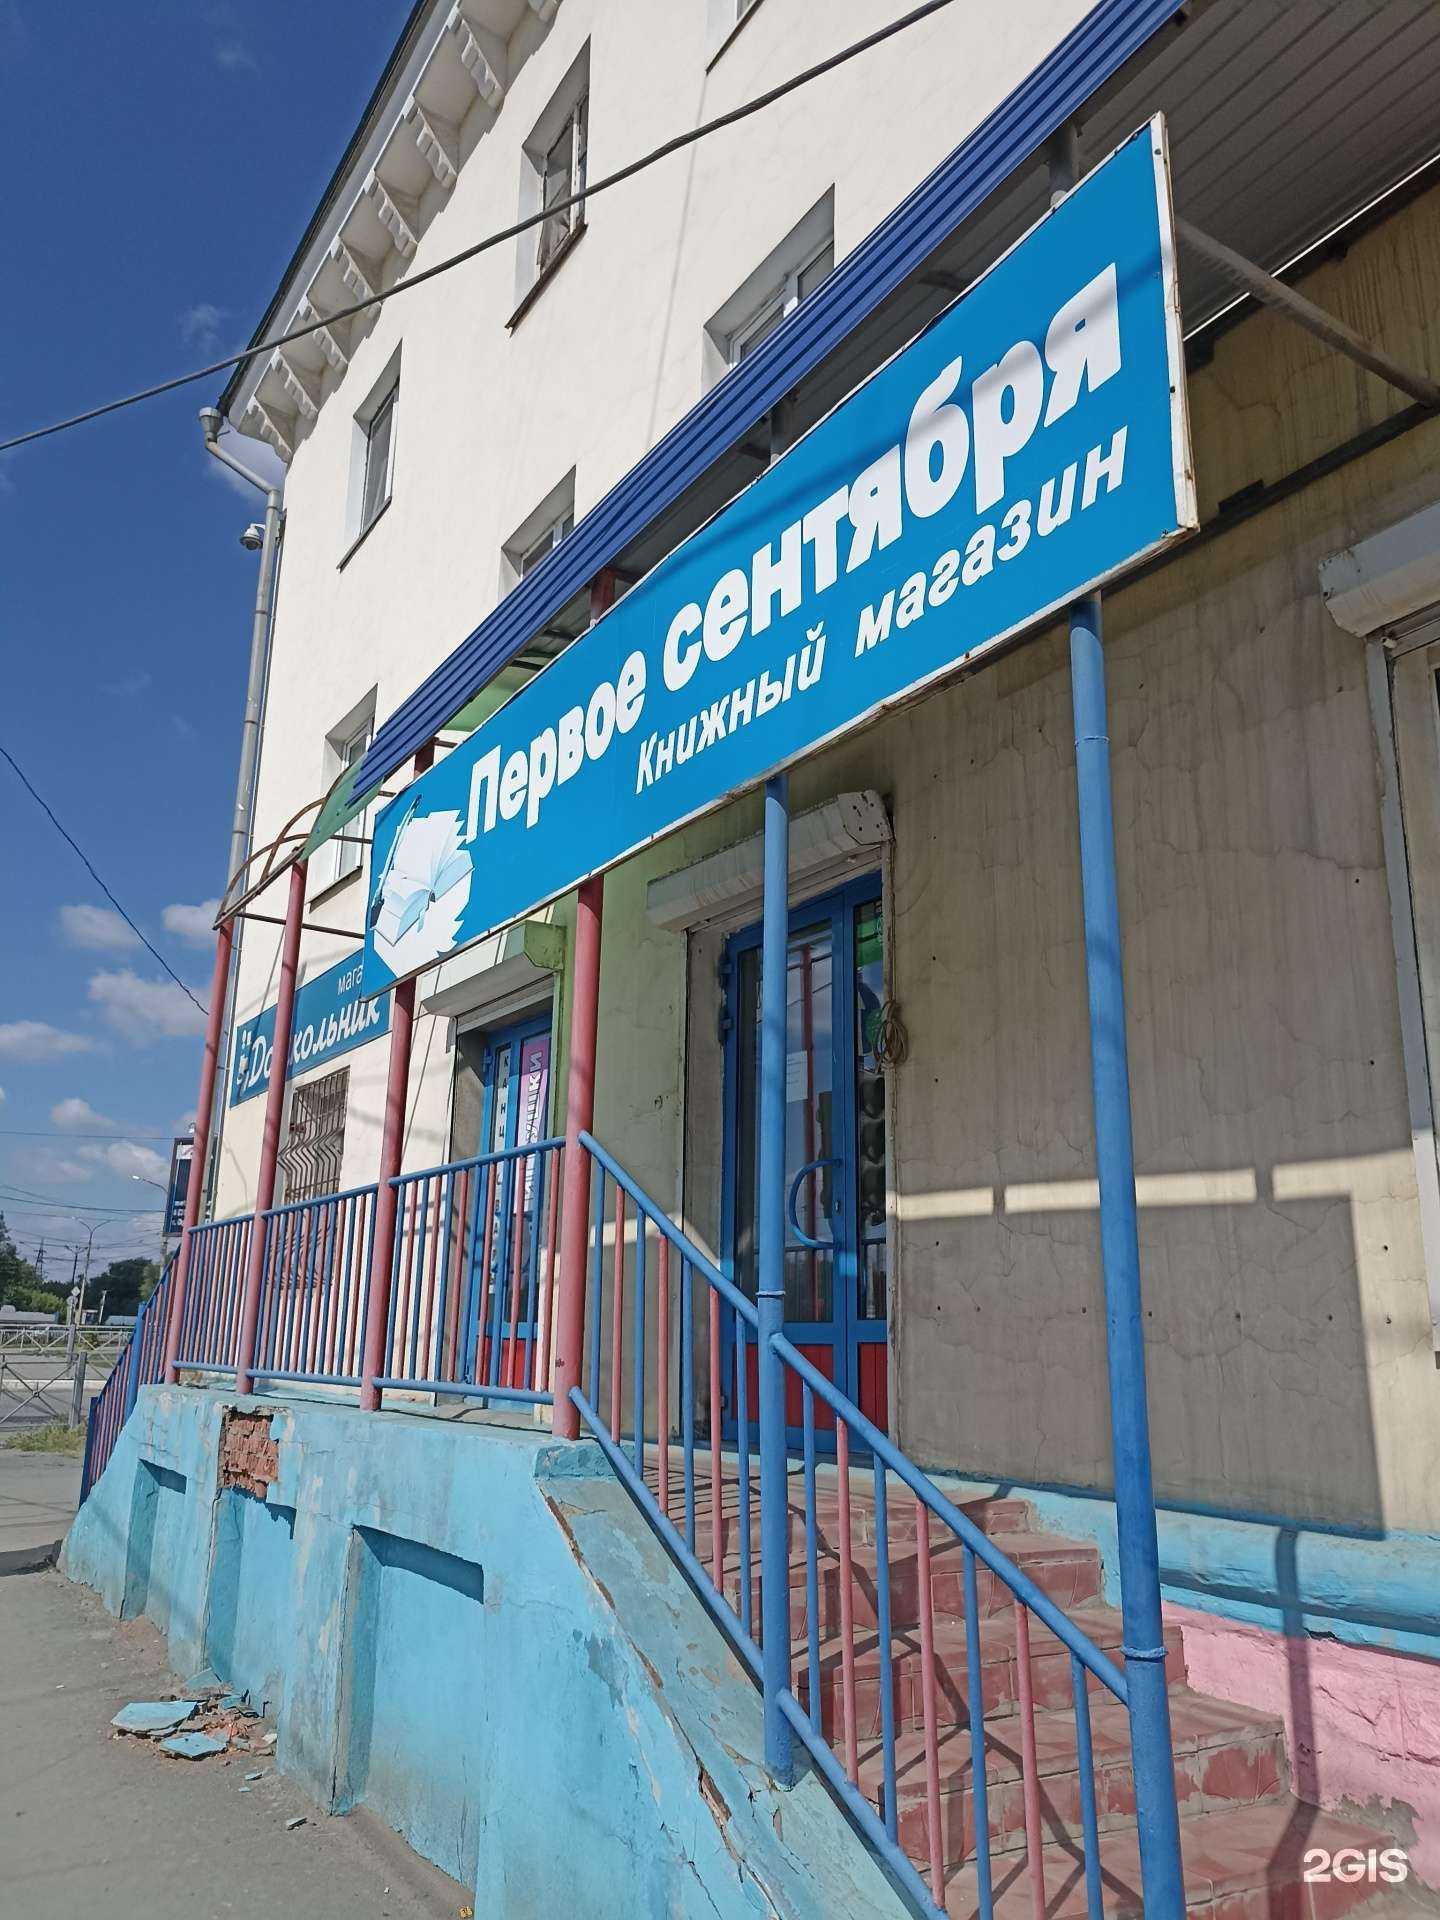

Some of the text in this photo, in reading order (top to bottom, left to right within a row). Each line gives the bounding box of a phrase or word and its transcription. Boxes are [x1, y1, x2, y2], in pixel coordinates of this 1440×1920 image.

[466, 263, 1122, 845] Первое сентября
[635, 425, 1128, 795] Книжный магазин
[248, 996, 380, 1088] Докольник
